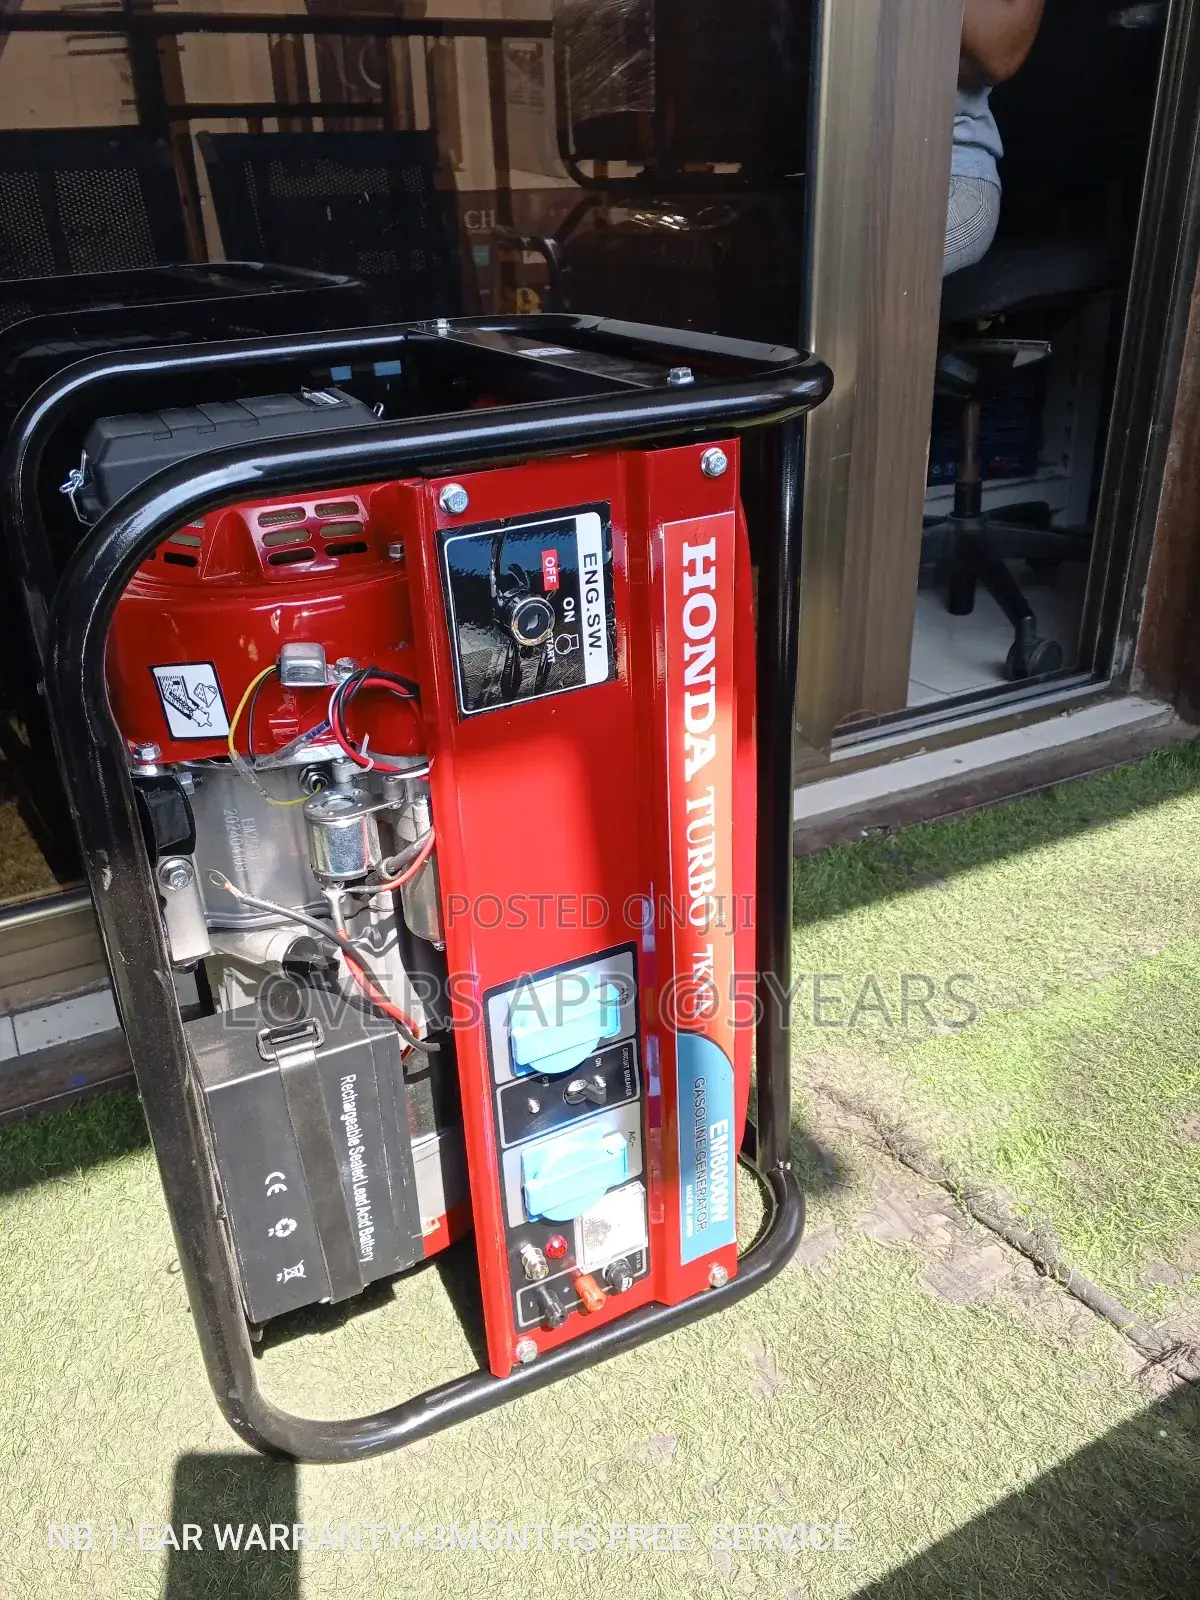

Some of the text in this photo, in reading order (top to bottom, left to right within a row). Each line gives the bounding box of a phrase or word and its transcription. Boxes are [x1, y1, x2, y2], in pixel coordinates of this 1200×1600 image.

[544, 556, 557, 584] OFF
[563, 597, 575, 623] ON
[583, 552, 602, 656] ENG.SW.
[682, 536, 718, 782] HONDA
[685, 784, 717, 927] TURBO
[596, 1057, 603, 1068] ON
[621, 1047, 634, 1097] CIRCUIT BREAKER
[340, 1073, 376, 1262] Rechargeable Sealed Lead Acid Battery
[693, 1076, 709, 1233] GASOLINE GENERATOR
